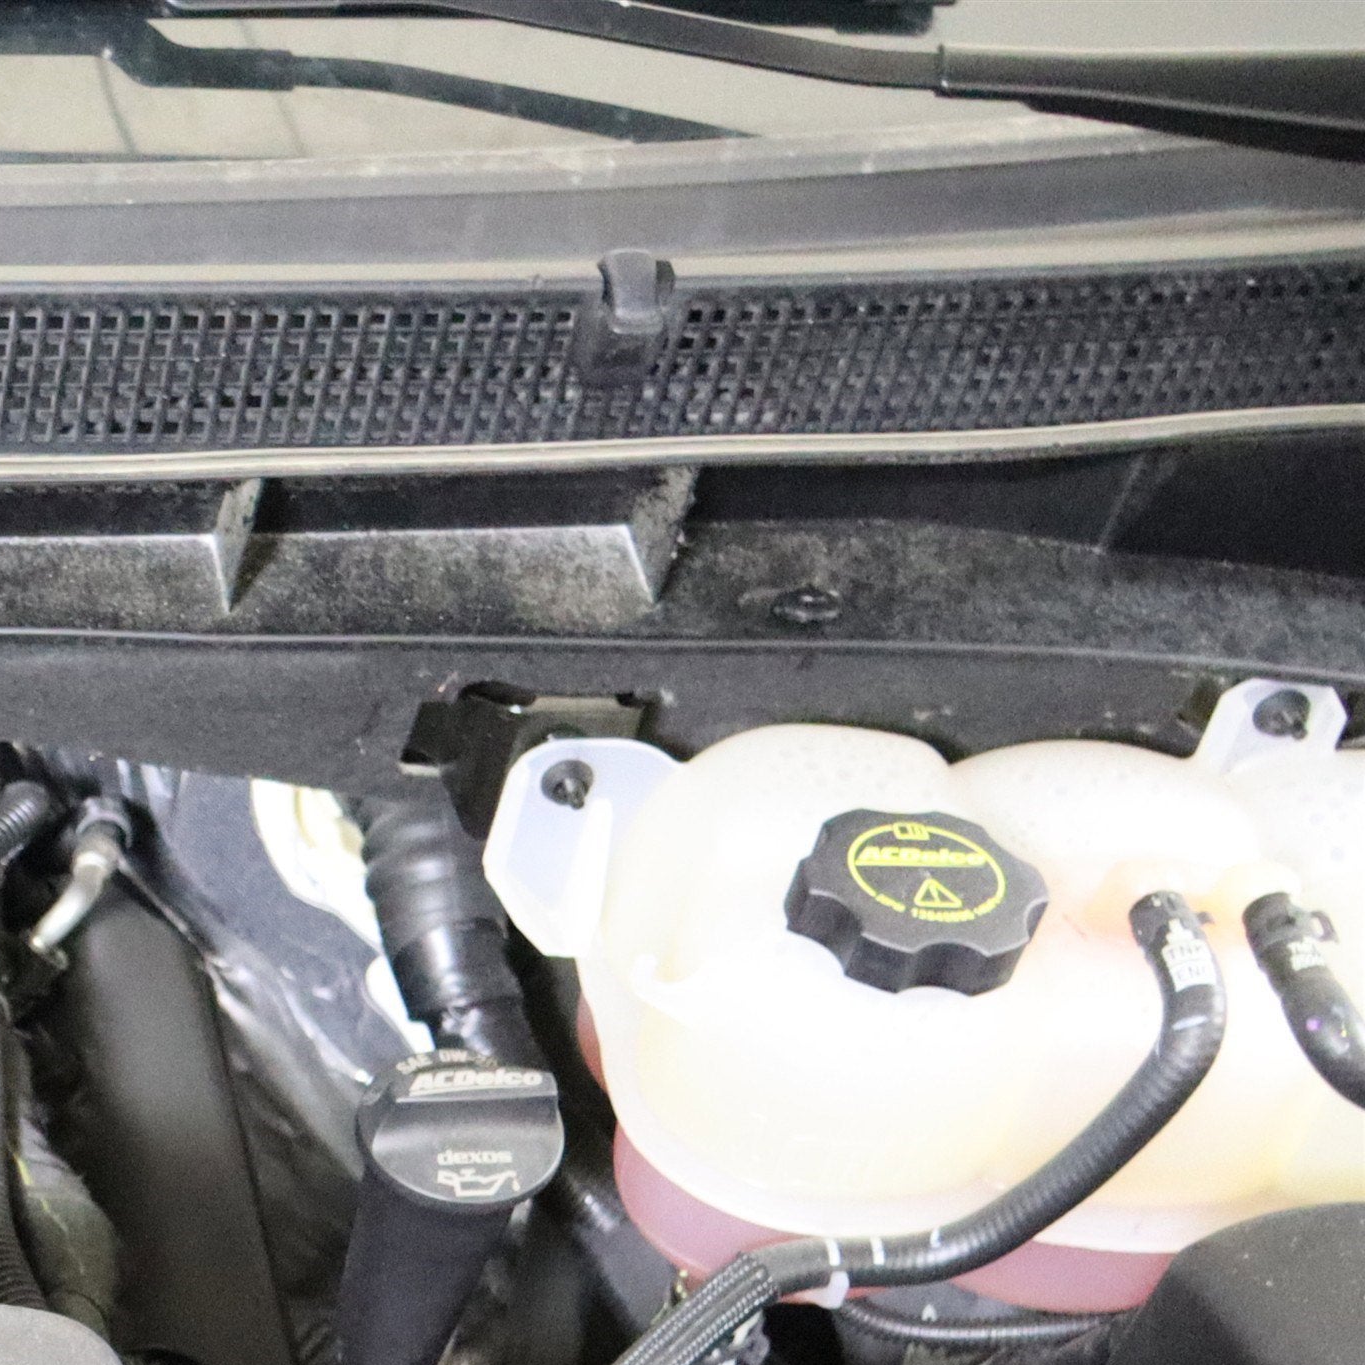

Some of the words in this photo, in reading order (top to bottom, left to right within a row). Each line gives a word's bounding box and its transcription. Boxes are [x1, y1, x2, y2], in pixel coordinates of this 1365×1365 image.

[855, 846, 987, 866] ACDelco
[395, 1052, 433, 1075] SAE
[409, 1068, 543, 1096] ACDelco
[436, 1149, 514, 1166] dexos
